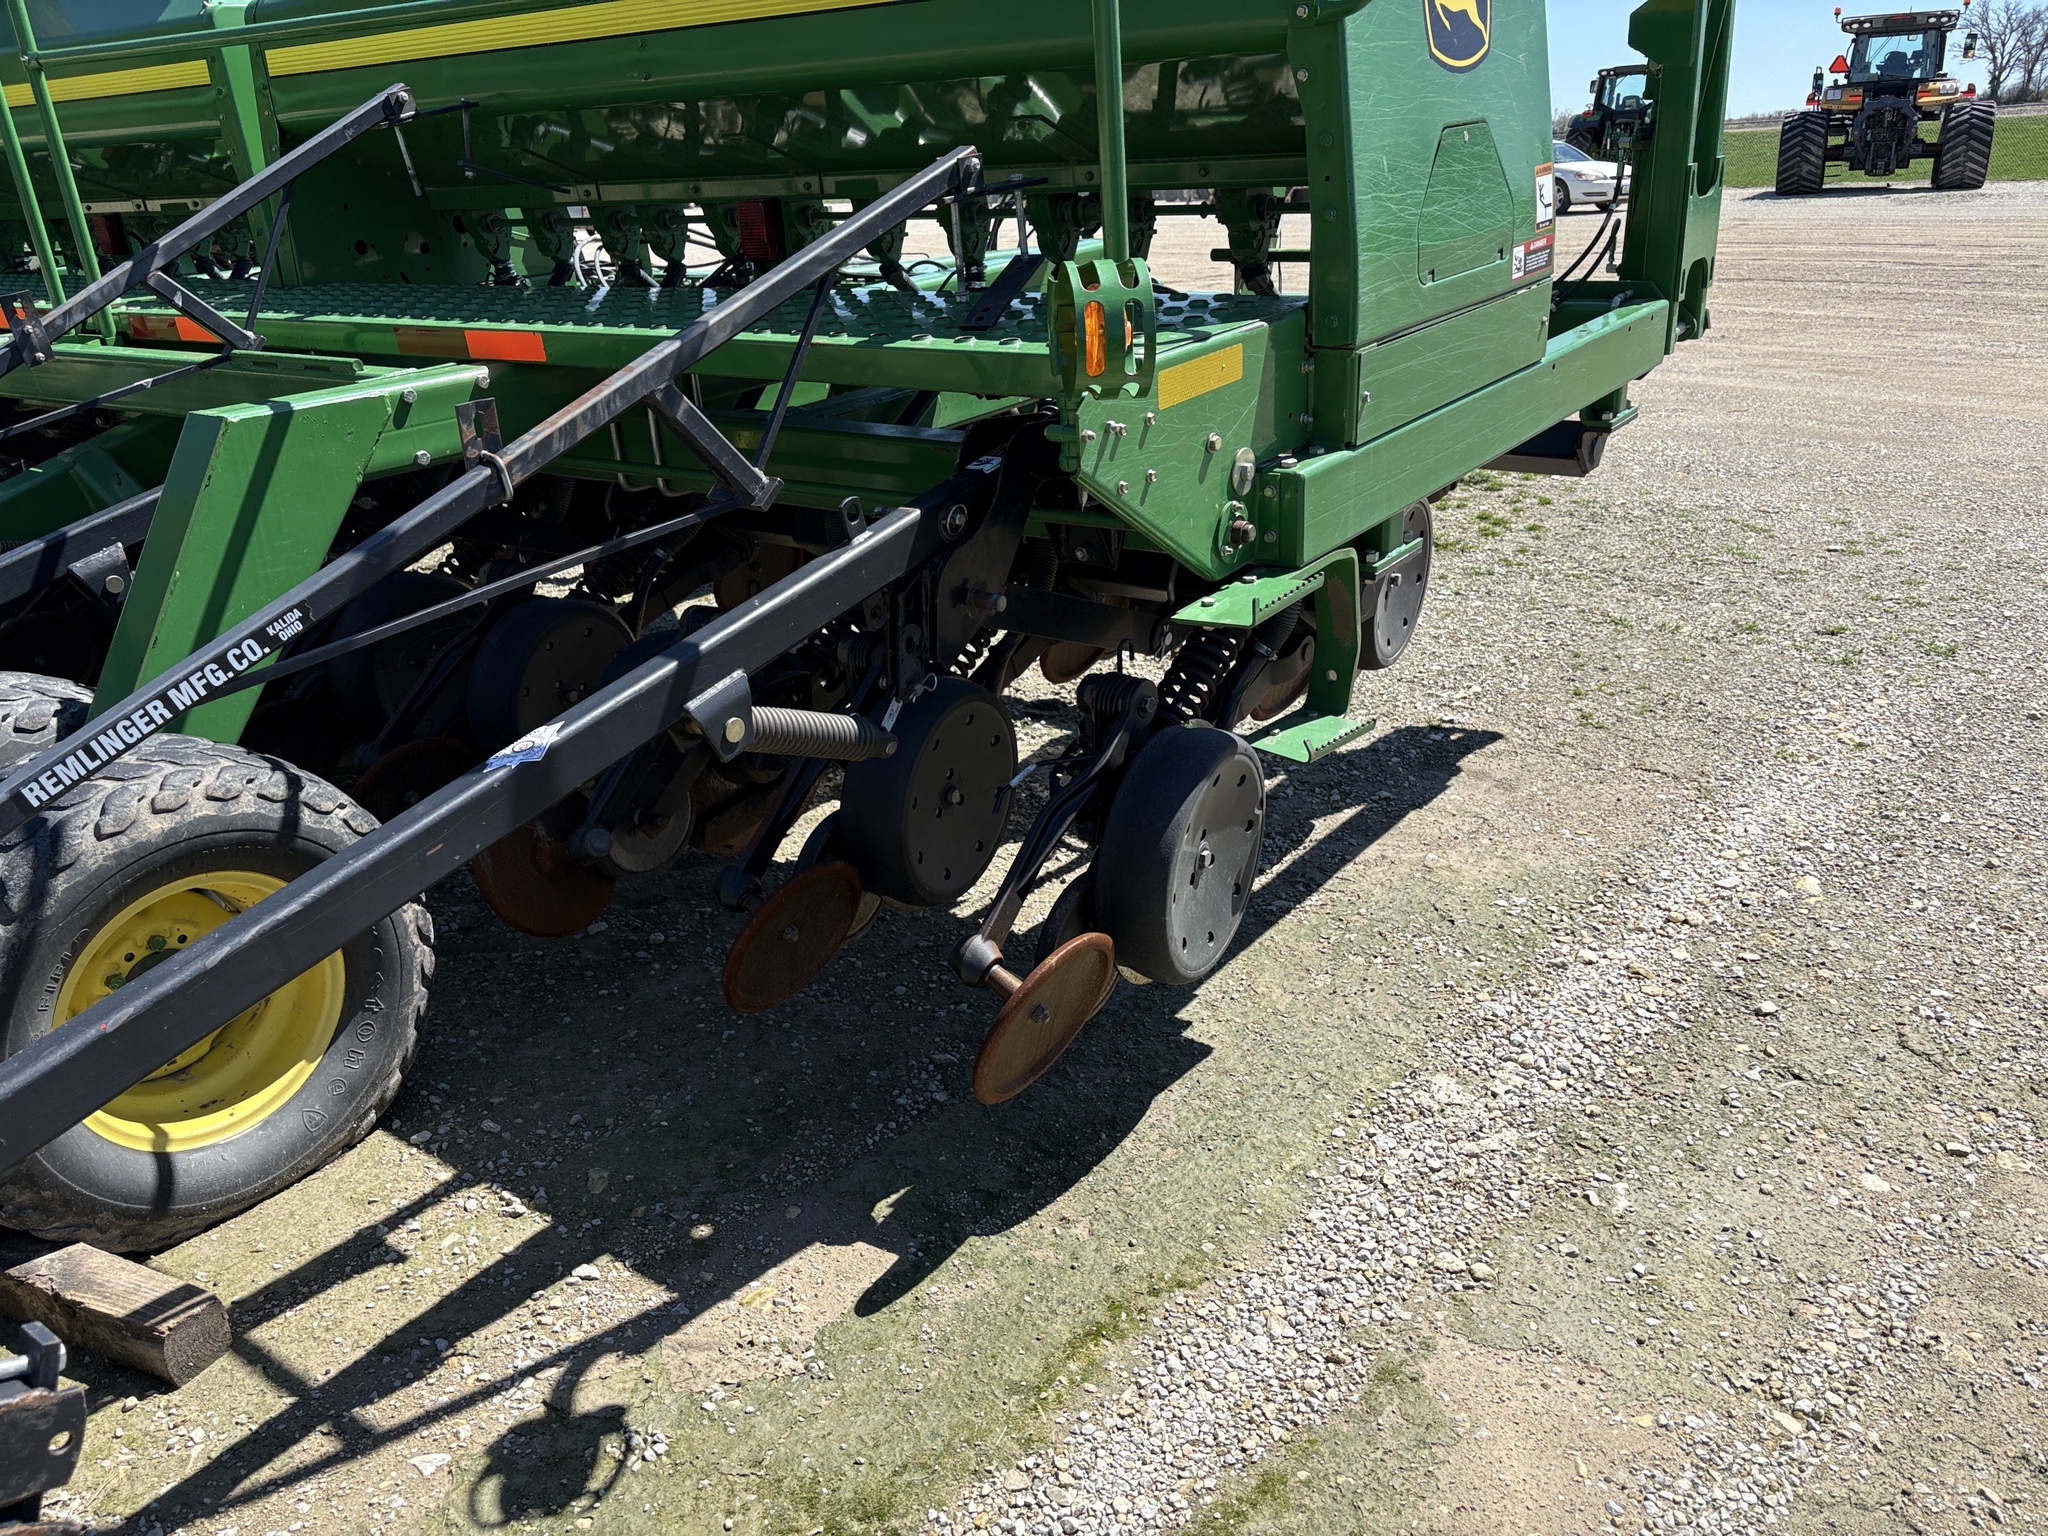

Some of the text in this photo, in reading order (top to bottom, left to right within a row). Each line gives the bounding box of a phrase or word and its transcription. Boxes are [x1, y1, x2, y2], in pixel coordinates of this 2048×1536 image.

[266, 608, 303, 636] KALIDA
[278, 621, 304, 642] OHIO
[20, 638, 271, 808] REMLINGER MFG. CO.
